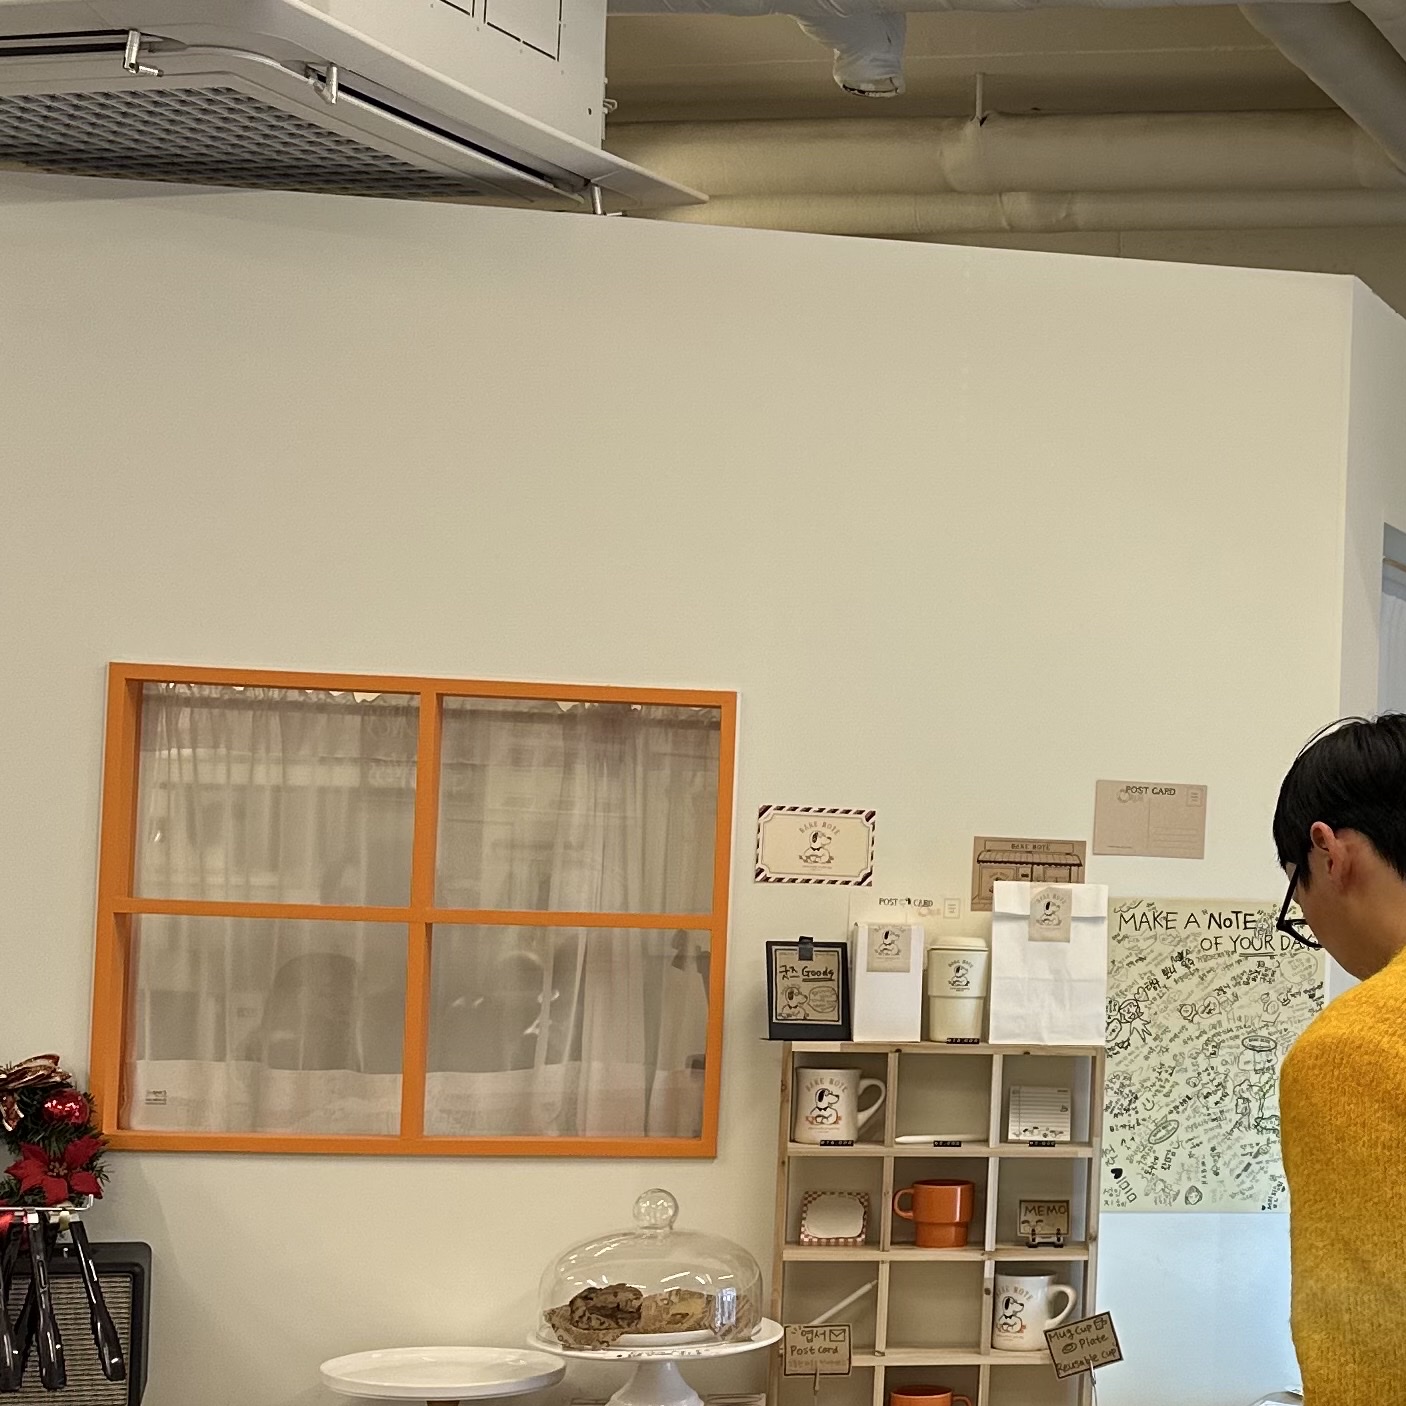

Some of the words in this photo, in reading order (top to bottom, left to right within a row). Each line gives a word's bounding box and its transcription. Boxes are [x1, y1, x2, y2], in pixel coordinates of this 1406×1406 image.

[1126, 786, 1149, 794] POST
[1152, 787, 1176, 795] CARD
[879, 898, 898, 906] POST
[913, 899, 933, 907] CARD
[1119, 911, 1178, 931] MAKE
[1184, 913, 1201, 930] A
[1200, 936, 1223, 951] OF
[1230, 935, 1276, 951] YOUR
[802, 966, 834, 980] Goods
[1025, 1206, 1067, 1217] MEMO
[801, 1330, 826, 1343] 엽서
[1048, 1329, 1074, 1342] Mug
[1075, 1324, 1092, 1335] Cup
[1079, 1335, 1108, 1348] Plate
[790, 1345, 815, 1356] Post
